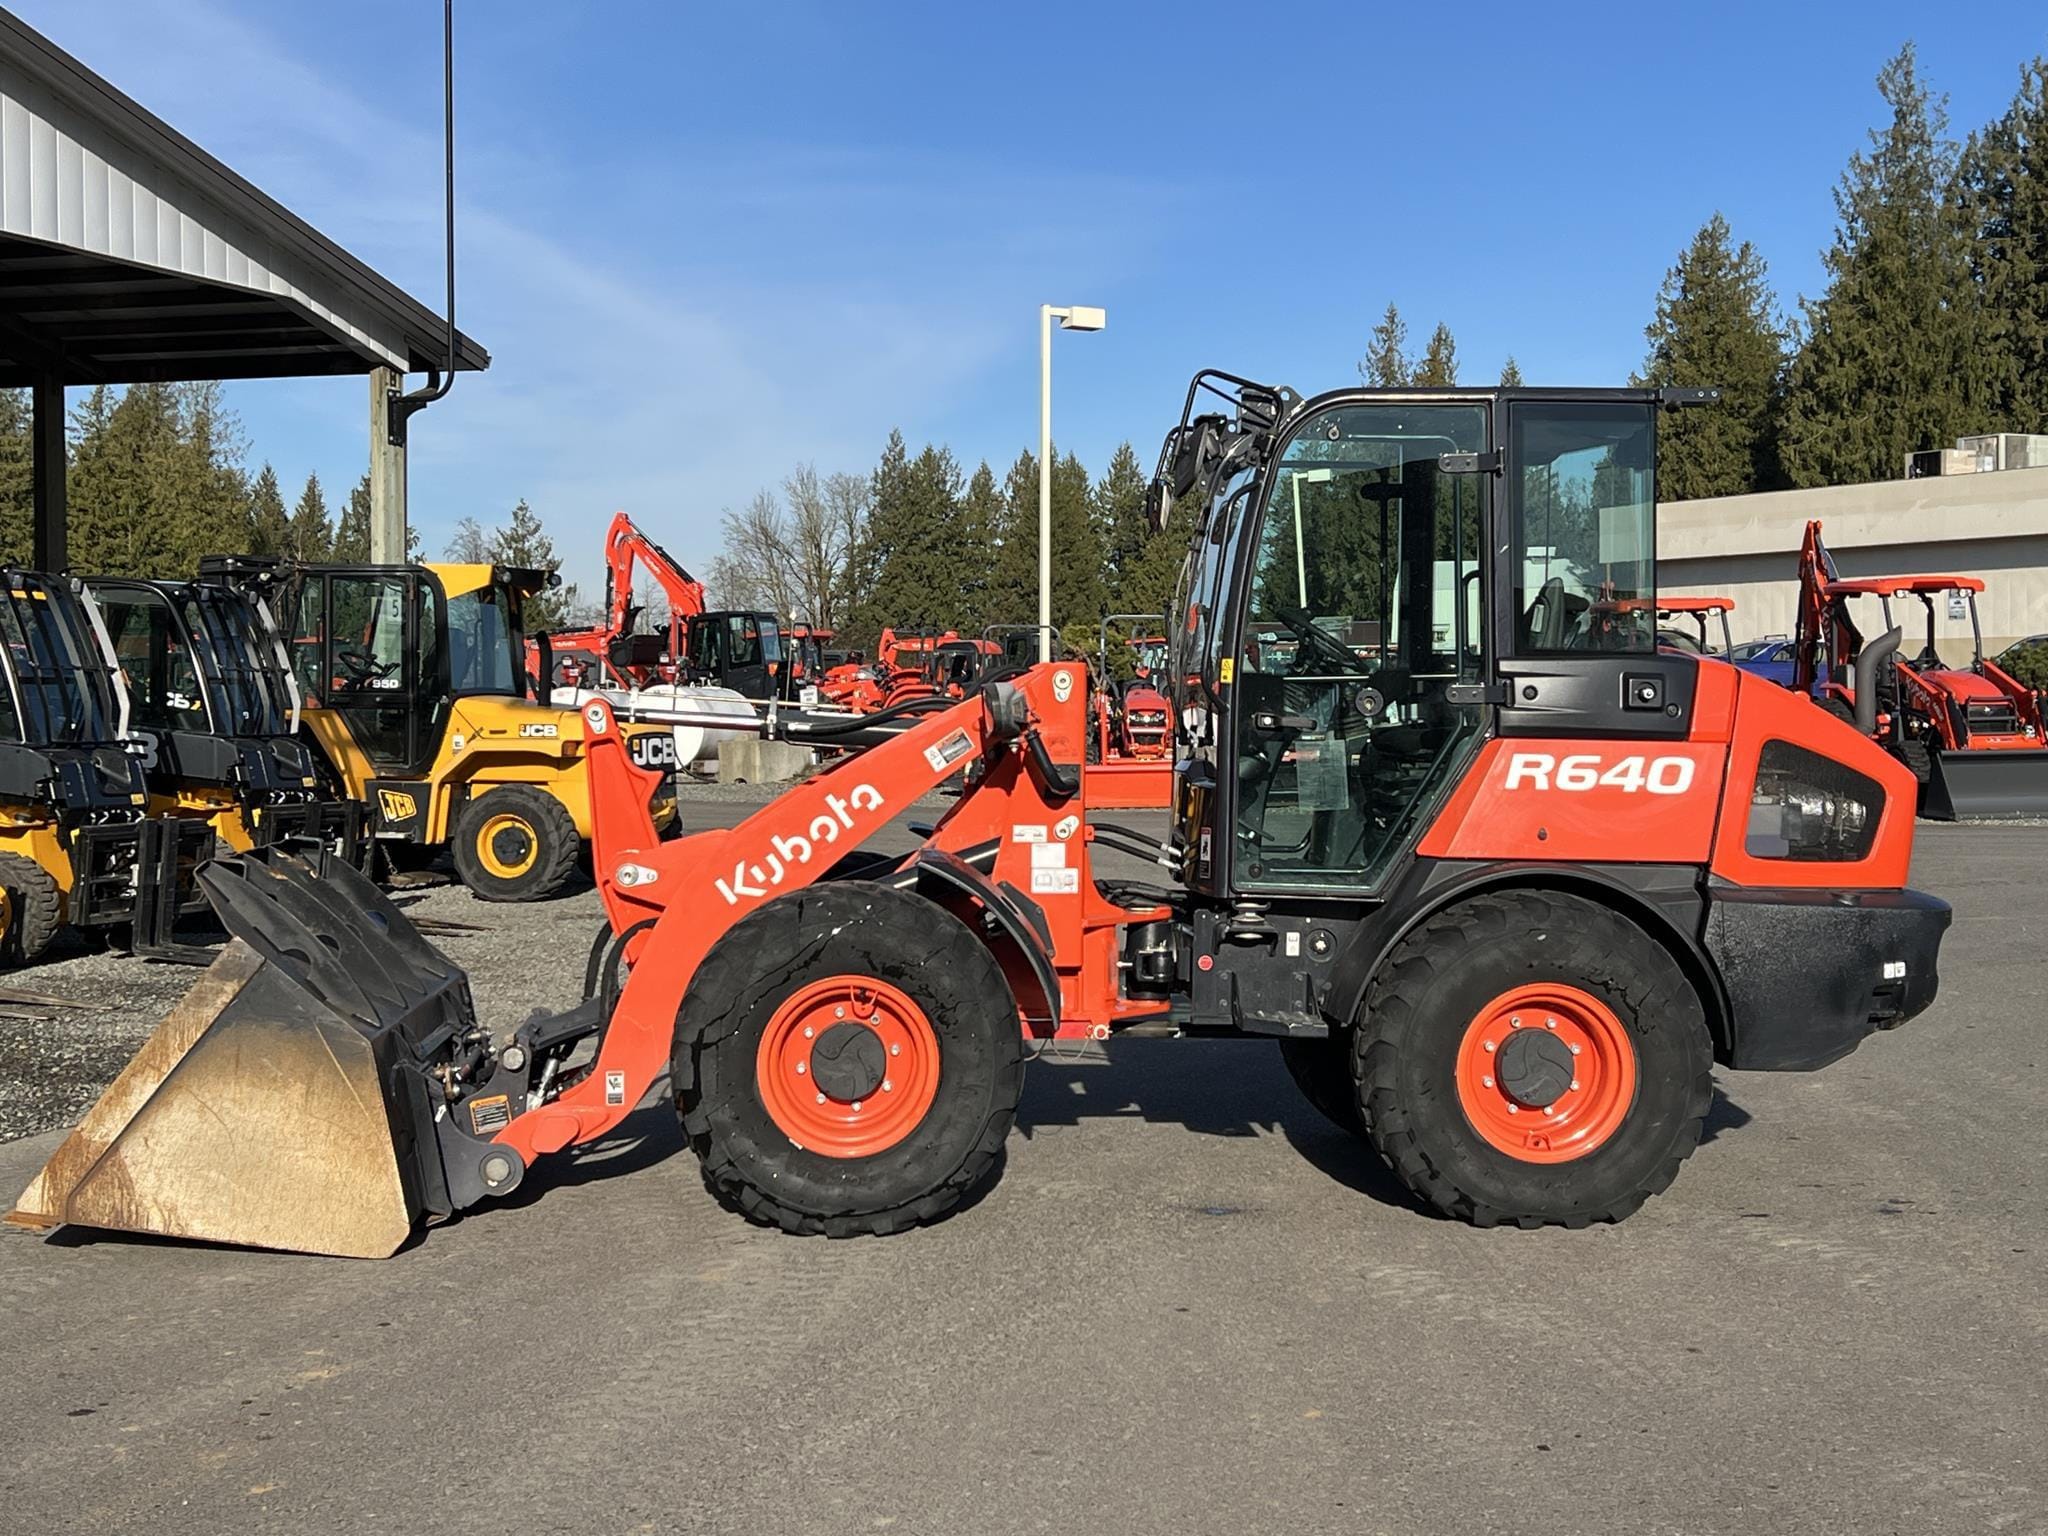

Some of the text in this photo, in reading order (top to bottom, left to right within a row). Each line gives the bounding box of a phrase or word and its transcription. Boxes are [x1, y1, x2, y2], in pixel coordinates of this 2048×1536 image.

[519, 724, 558, 737] JCB
[633, 738, 675, 766] JCB
[1504, 753, 1696, 795] R640
[385, 793, 414, 820] JCB
[714, 784, 885, 906] Kubota
